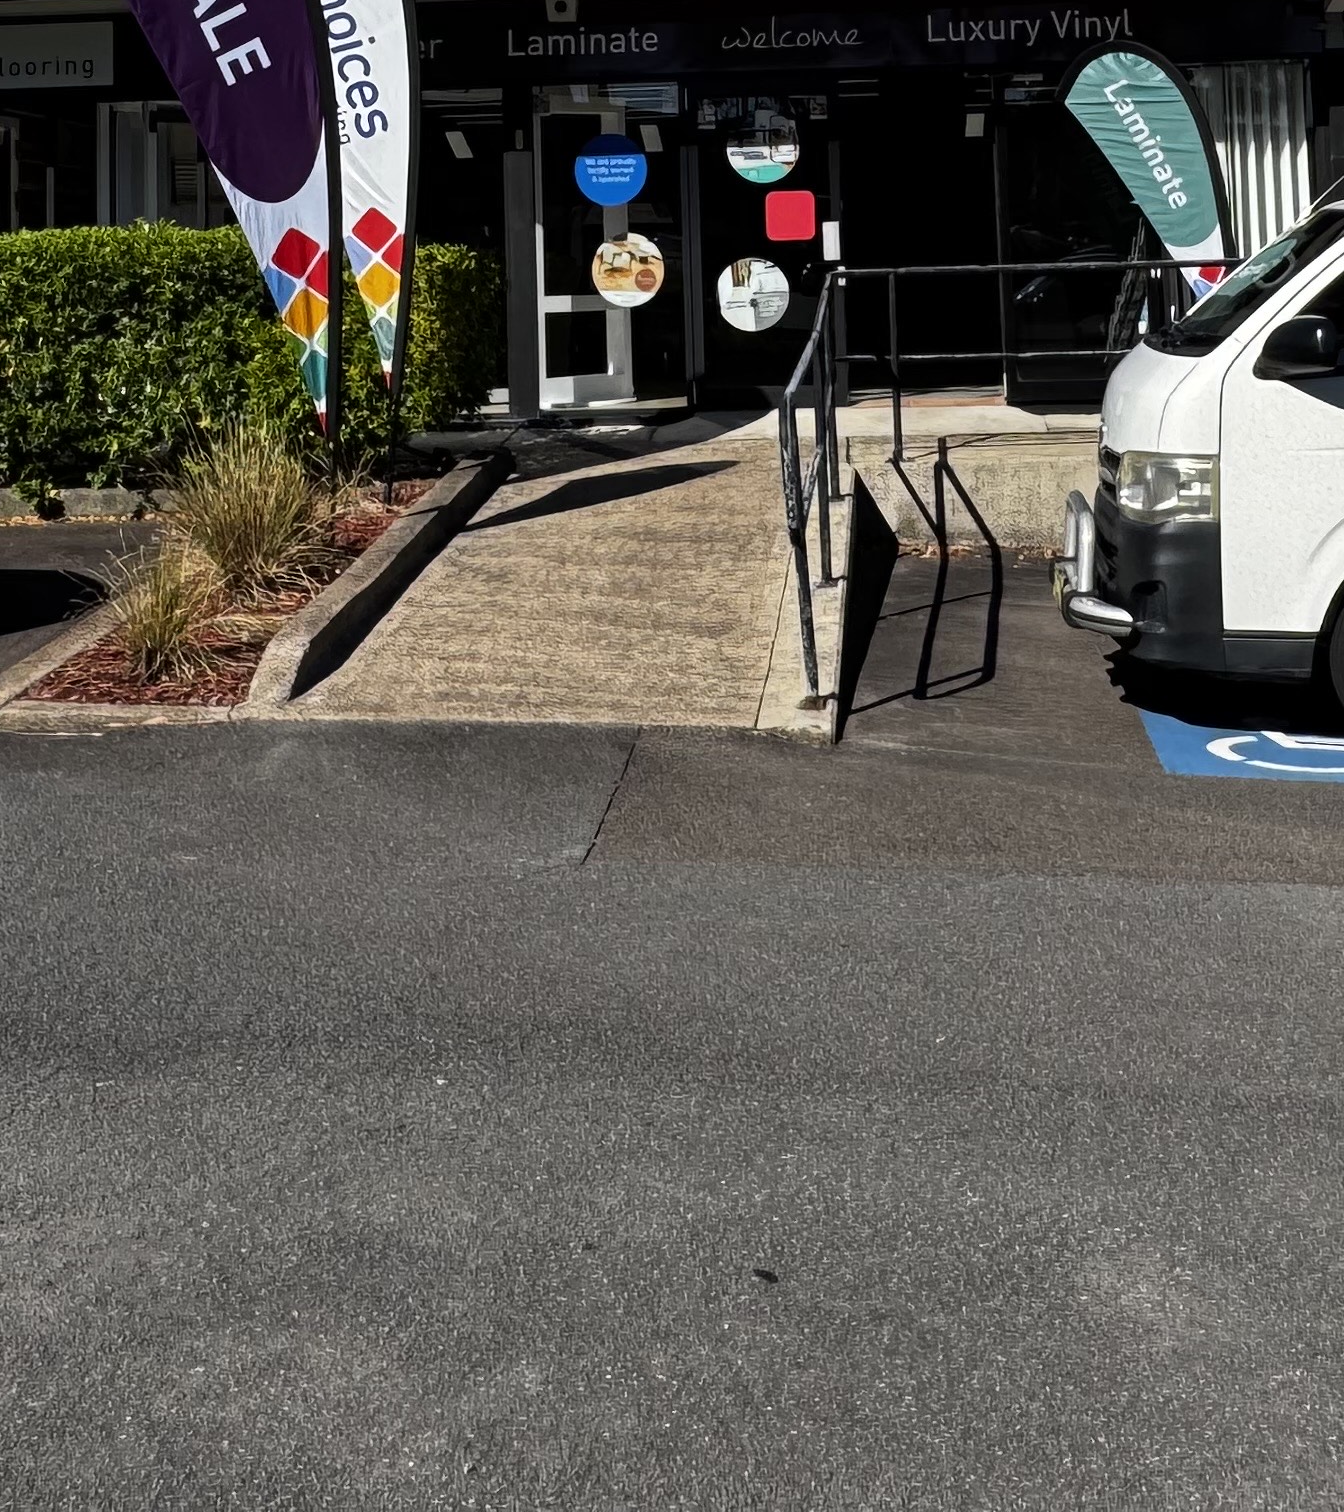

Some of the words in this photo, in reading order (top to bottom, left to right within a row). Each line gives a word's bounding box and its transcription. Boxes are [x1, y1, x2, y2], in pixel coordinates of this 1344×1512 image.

[507, 27, 659, 57] Laminate
[721, 16, 865, 49] welcome
[926, 14, 1041, 47] Luxury
[1050, 8, 1134, 43] Vinyl
[1103, 79, 1187, 210] Laminate
